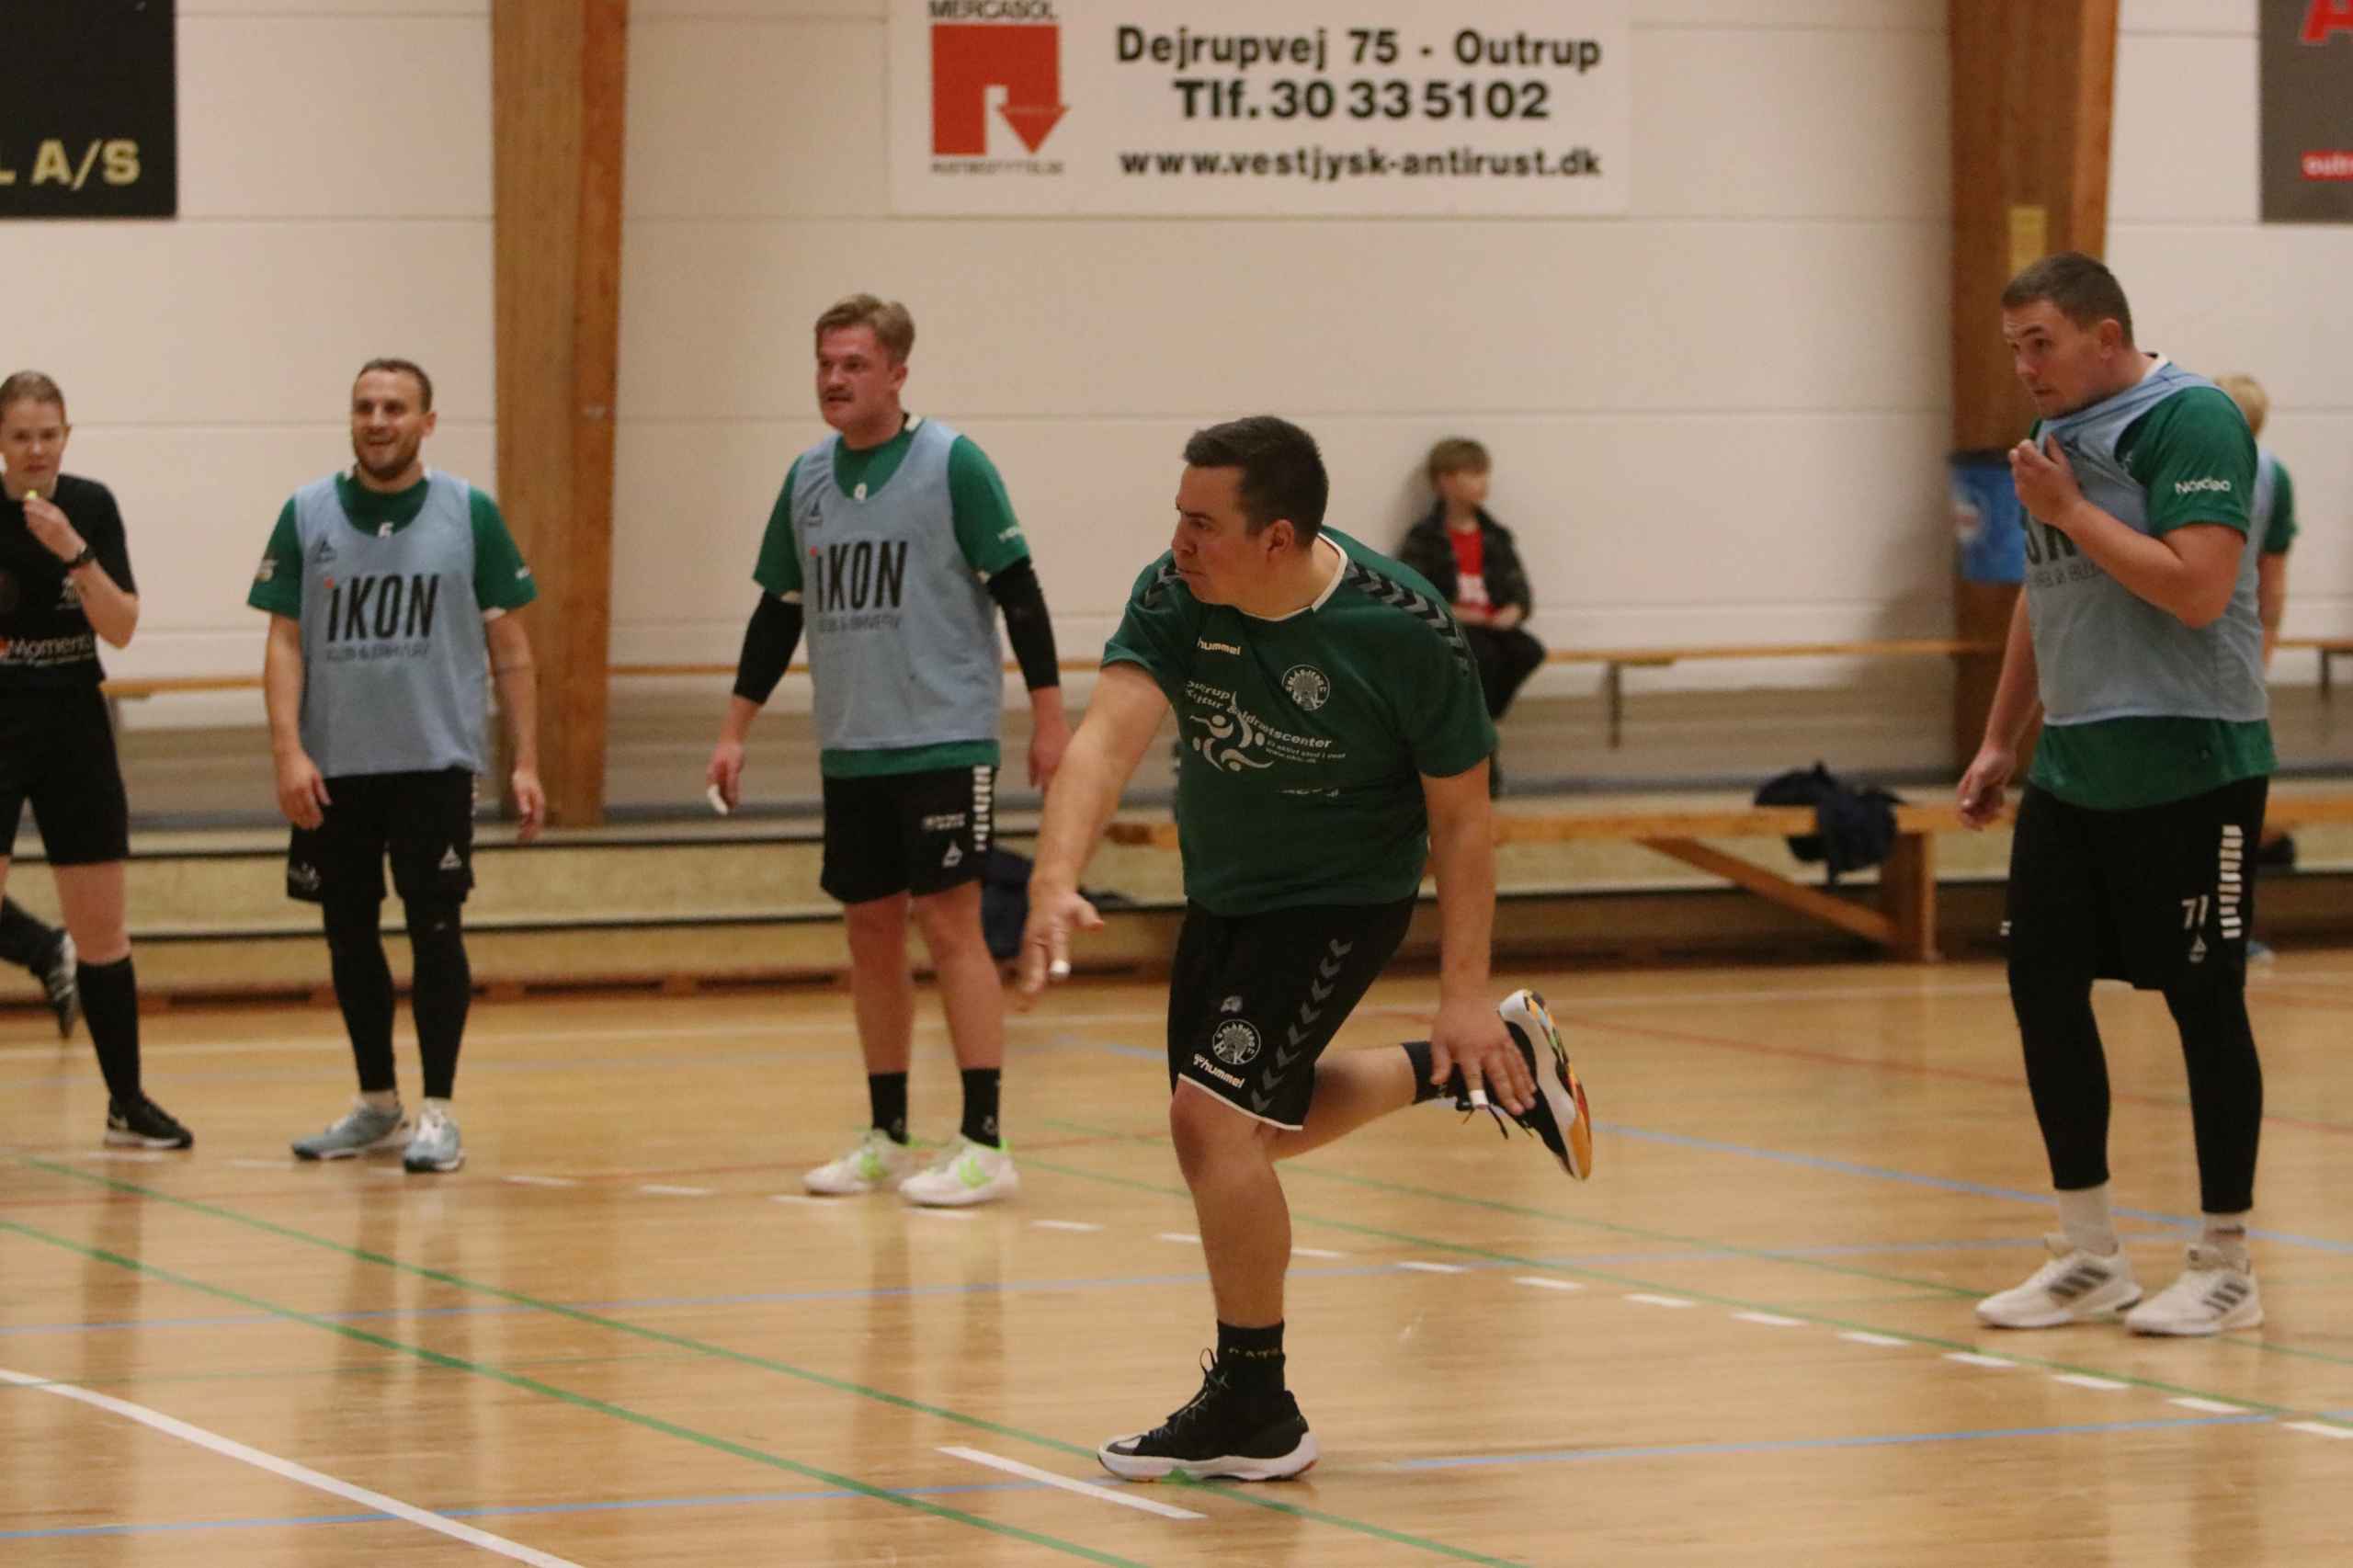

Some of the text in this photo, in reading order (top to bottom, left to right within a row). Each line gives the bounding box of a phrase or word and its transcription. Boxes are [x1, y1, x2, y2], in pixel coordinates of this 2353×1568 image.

[1117, 26, 1326, 73] Dejrupvej
[1348, 29, 1398, 64] 75
[1455, 29, 1601, 73] Outrup
[1173, 79, 1259, 119] Tlf.
[1270, 80, 1336, 119] 30
[31, 139, 141, 191] A/S
[1119, 148, 1601, 182] www.vestjysk-antirust.dk
[1198, 636, 1241, 656] hummel
[2181, 895, 2210, 930] 71
[1200, 1058, 1246, 1088] hummel
